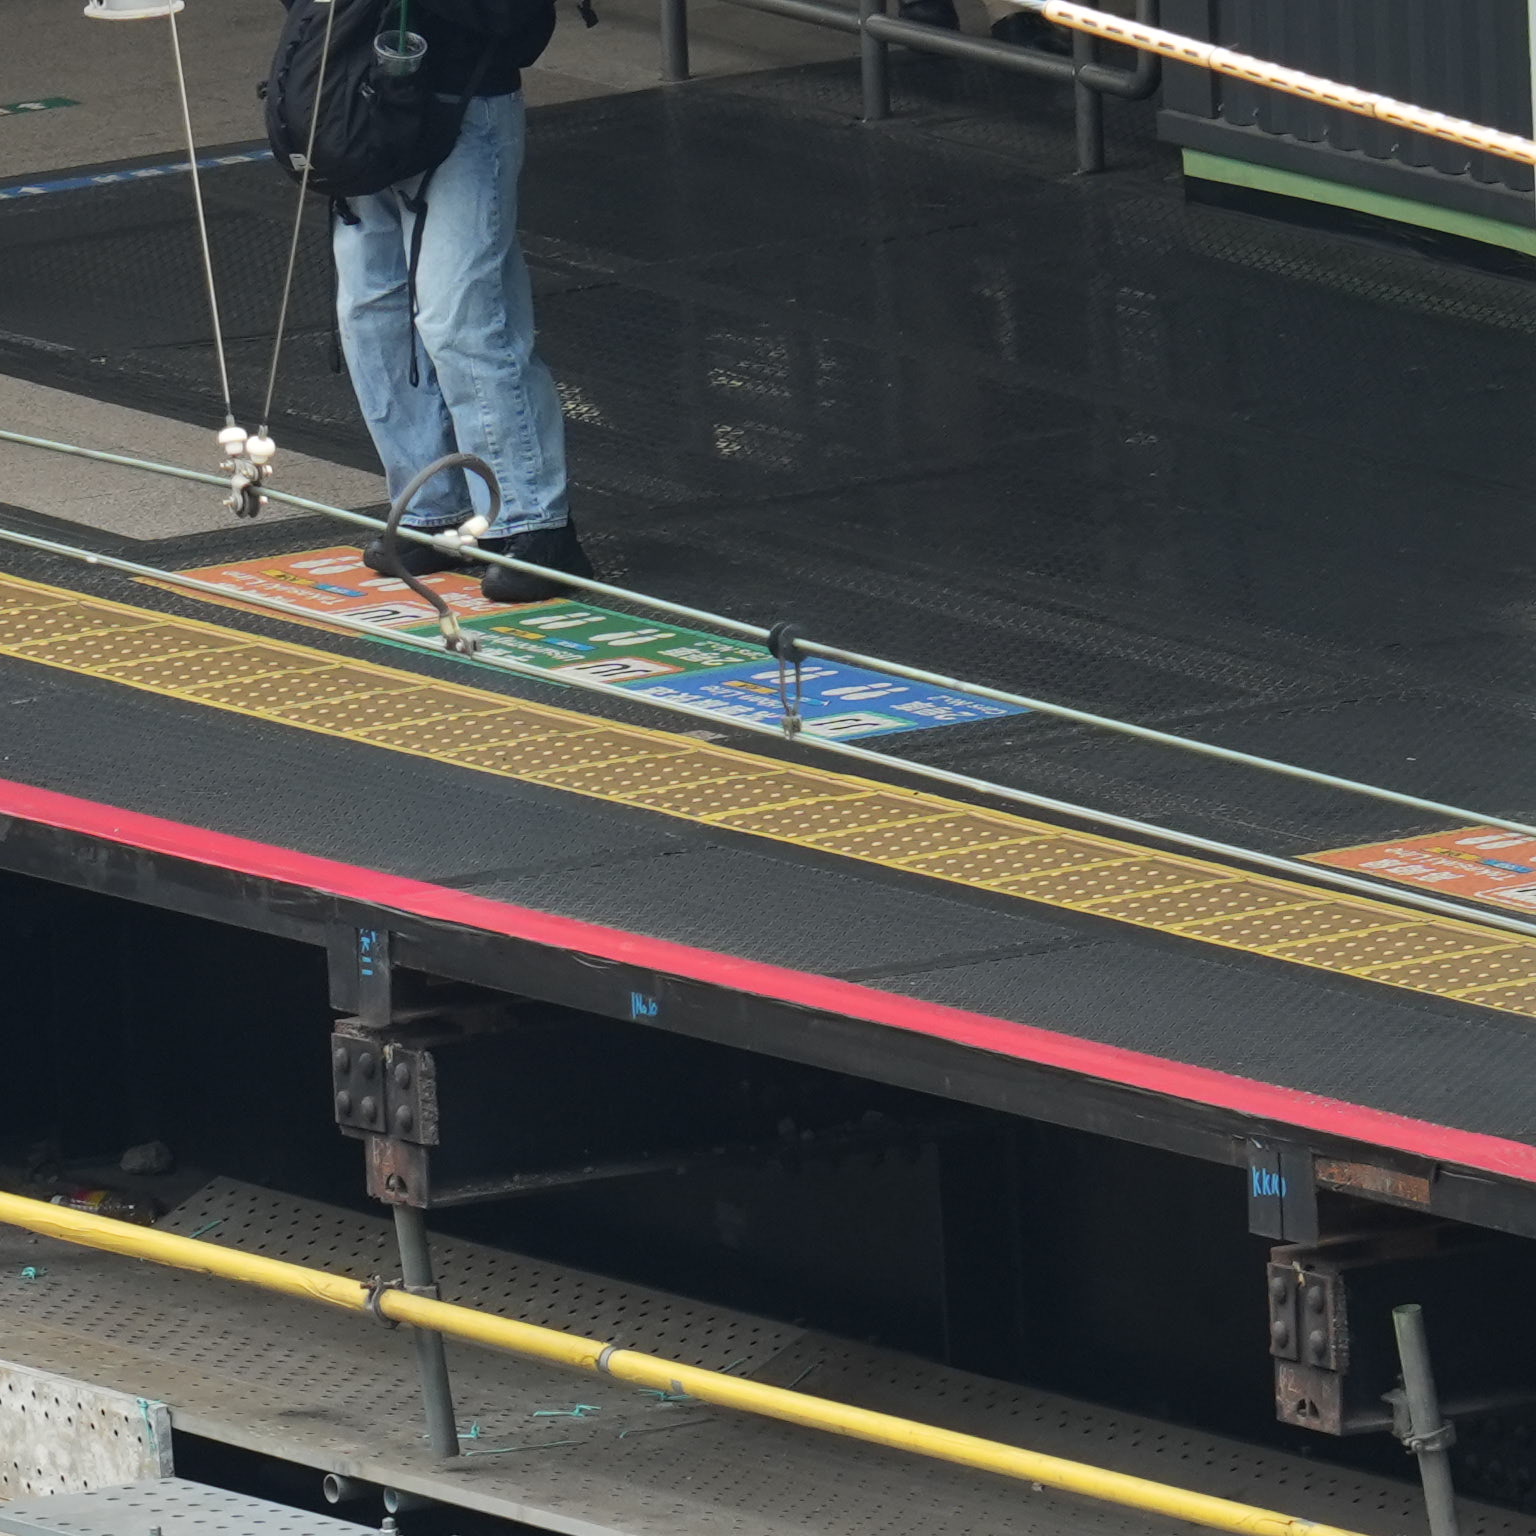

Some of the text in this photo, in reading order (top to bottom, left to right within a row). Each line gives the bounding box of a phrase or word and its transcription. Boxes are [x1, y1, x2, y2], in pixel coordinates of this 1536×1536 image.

[348, 608, 421, 625] JU
[576, 662, 650, 678] JU
[809, 718, 881, 731] JJ
